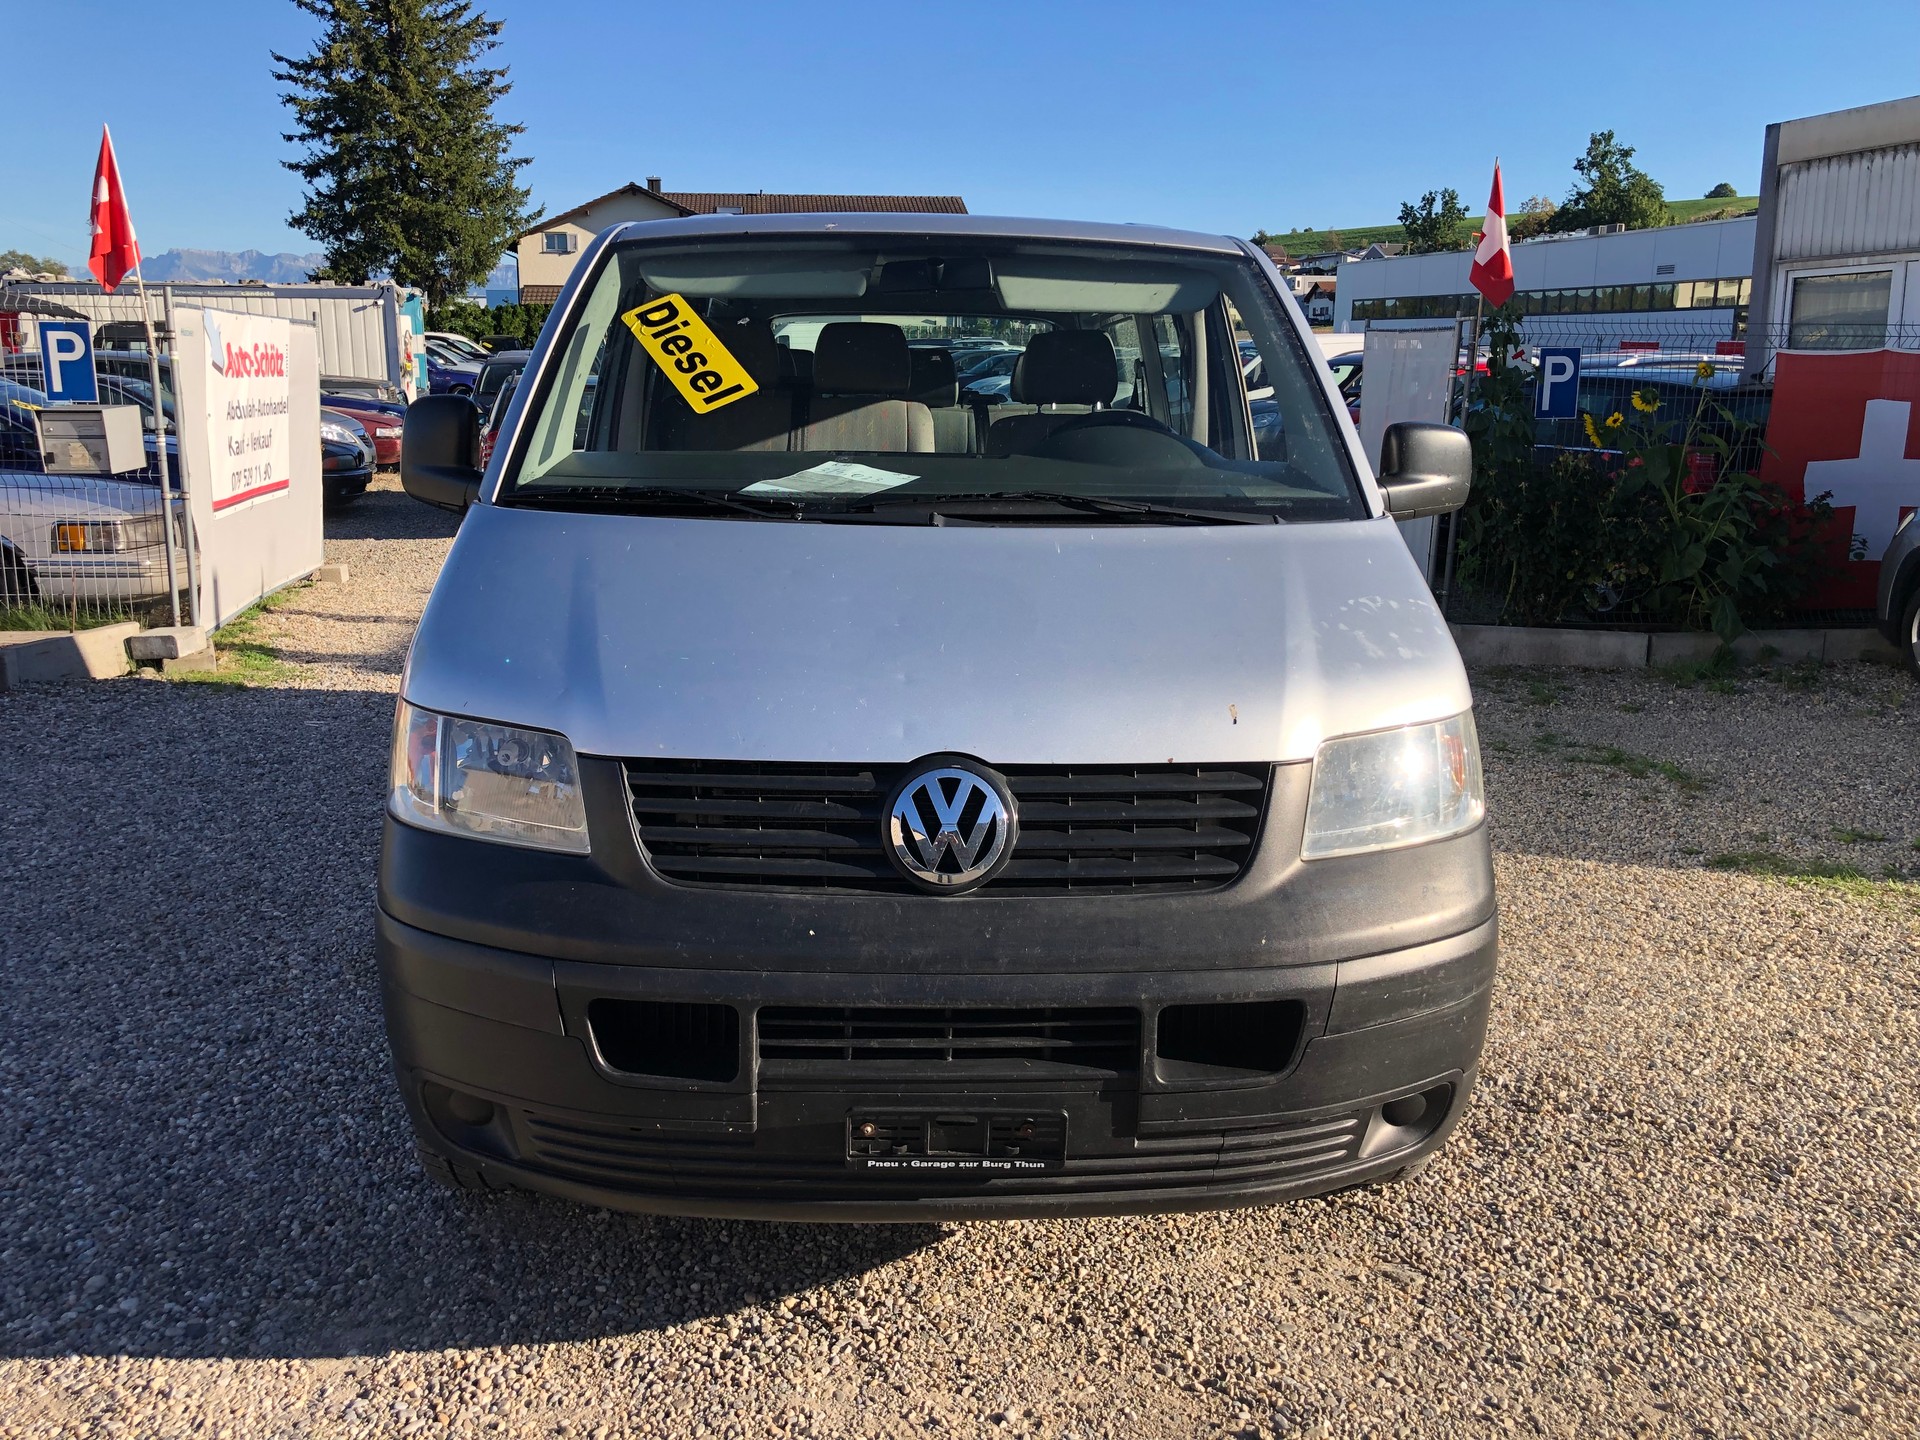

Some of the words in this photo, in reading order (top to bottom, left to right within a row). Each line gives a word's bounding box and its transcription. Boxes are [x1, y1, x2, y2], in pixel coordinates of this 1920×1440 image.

[46, 330, 86, 393] P
[225, 342, 284, 378] Auto-Schötz
[635, 300, 745, 405] Diesel
[1541, 355, 1575, 411] P
[867, 1160, 899, 1168] Pneu
[911, 1160, 956, 1169] Garage
[982, 1160, 1012, 1169] Burg
[1014, 1160, 1046, 1168] Thun
